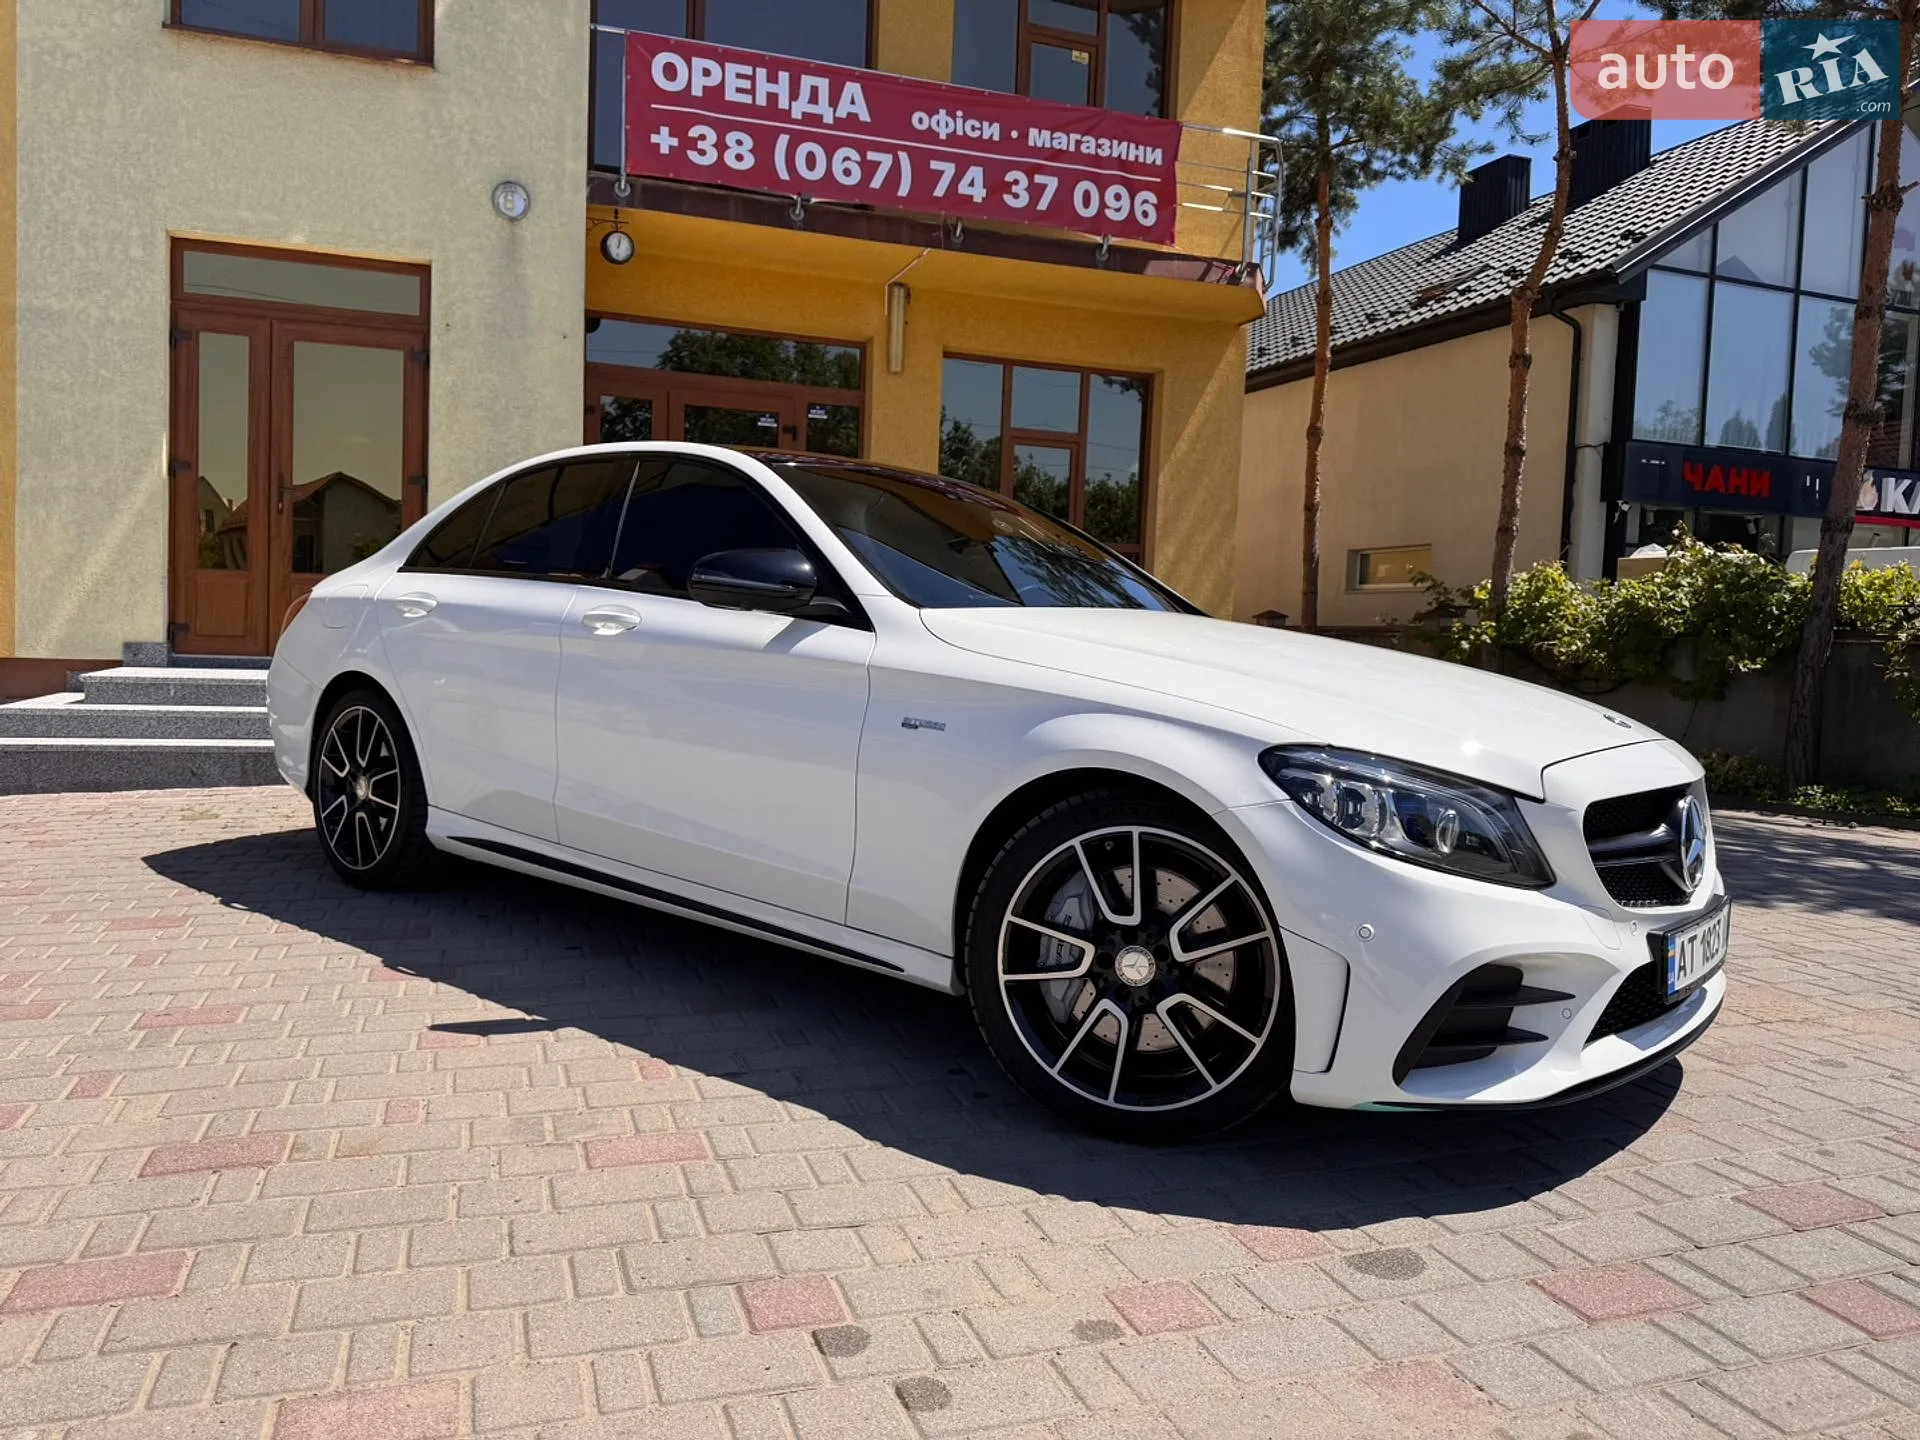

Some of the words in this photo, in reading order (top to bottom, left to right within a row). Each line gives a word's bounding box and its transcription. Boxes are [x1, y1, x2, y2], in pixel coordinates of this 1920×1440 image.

[651, 52, 871, 122] ОРЕНДА
[911, 109, 1000, 142] офіси
[1028, 127, 1163, 166] магазини
[650, 125, 756, 171] +38
[775, 133, 912, 197] (067)
[929, 159, 987, 203] 74
[1002, 170, 1059, 211] 37
[1073, 180, 1158, 227] 096
[1677, 935, 1698, 980] AT
